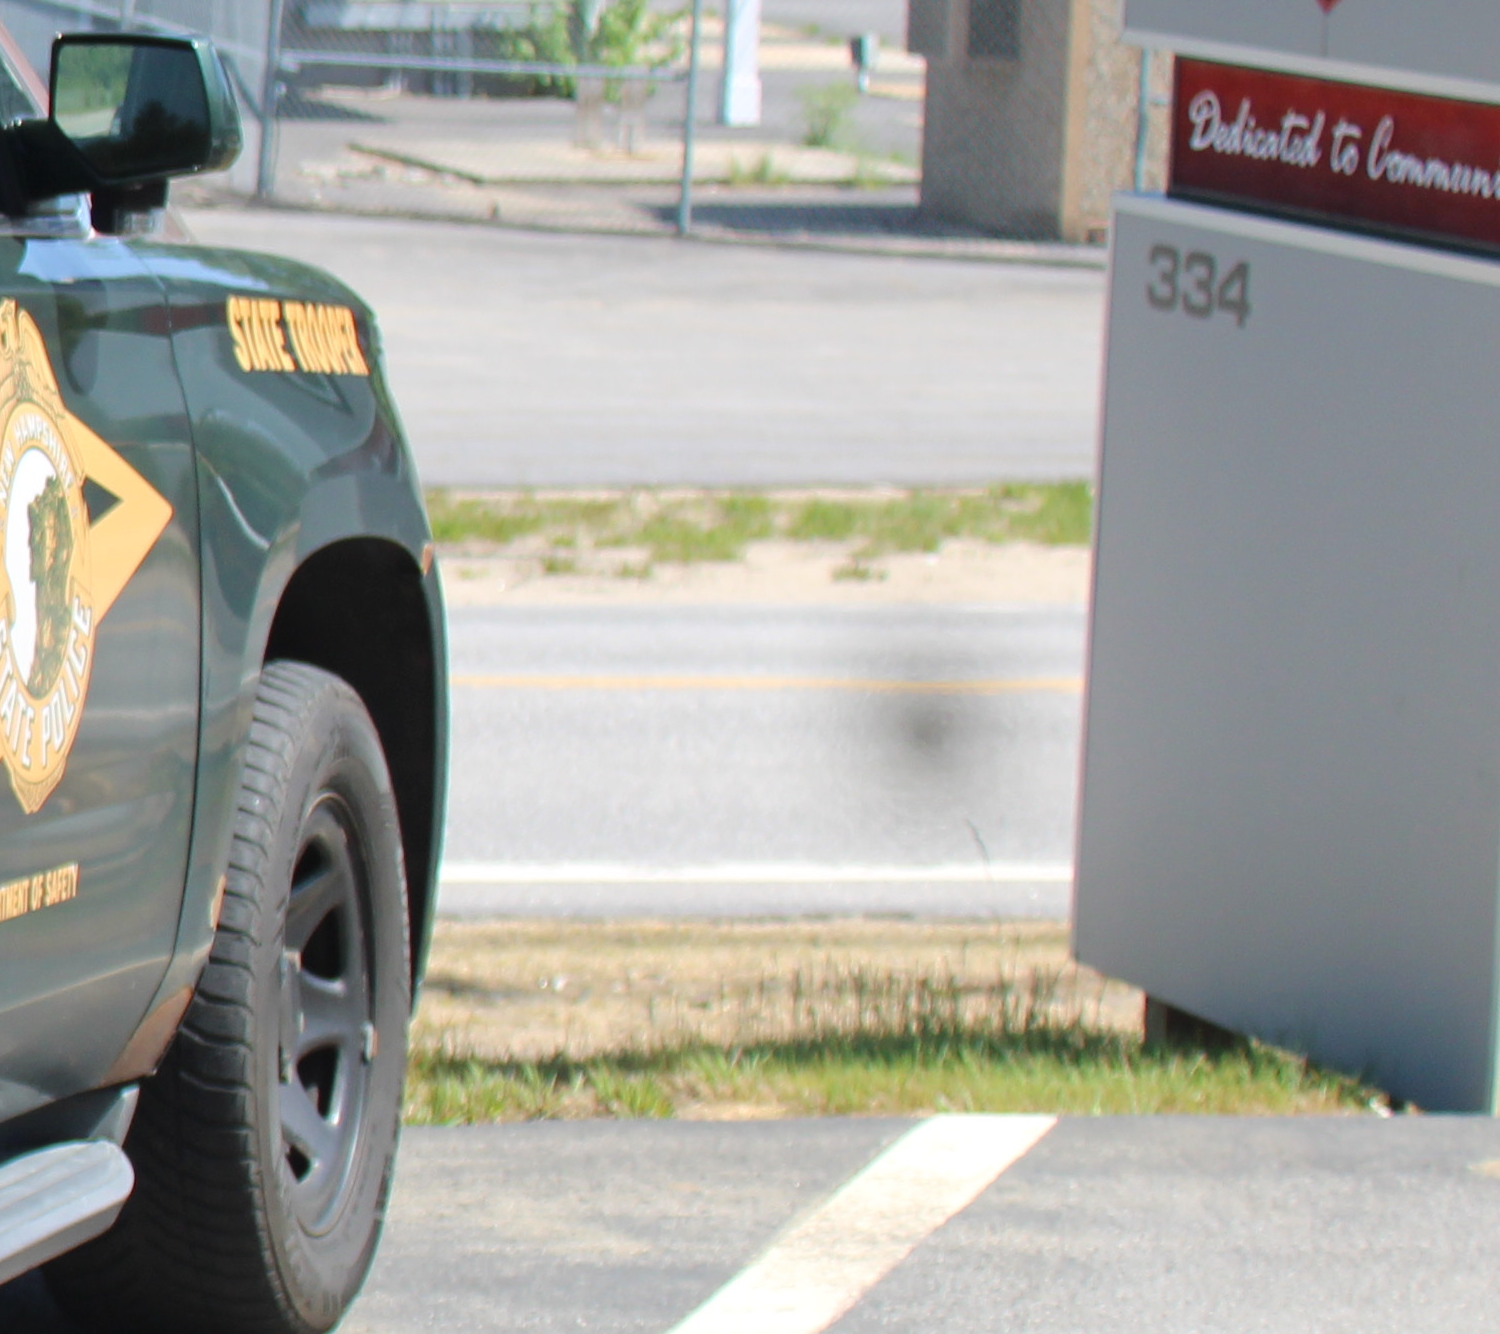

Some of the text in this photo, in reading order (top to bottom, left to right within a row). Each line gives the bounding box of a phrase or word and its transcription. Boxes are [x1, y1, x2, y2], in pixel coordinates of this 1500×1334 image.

[1189, 89, 1326, 169] Dedicated
[1331, 119, 1362, 176] to
[1146, 244, 1252, 329] 334
[227, 295, 296, 372] STATE
[41, 595, 92, 770] POLICE
[31, 873, 45, 911] OF
[45, 862, 79, 907] SAFETY
